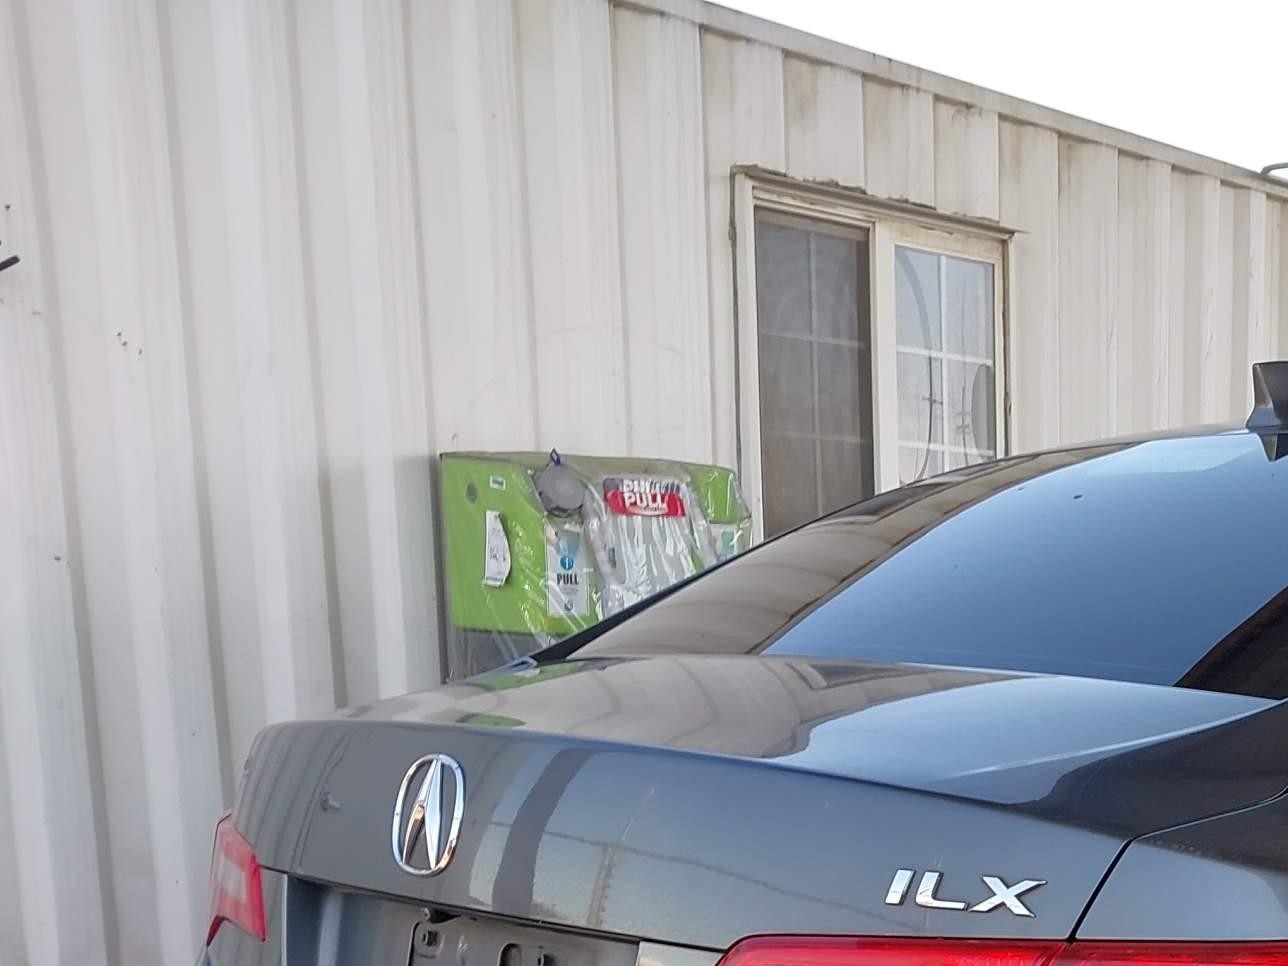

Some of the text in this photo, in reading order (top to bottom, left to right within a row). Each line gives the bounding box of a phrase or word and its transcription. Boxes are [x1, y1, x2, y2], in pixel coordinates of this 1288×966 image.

[624, 493, 666, 508] PULL
[556, 573, 580, 585] PULL
[884, 868, 1049, 919] ILX
